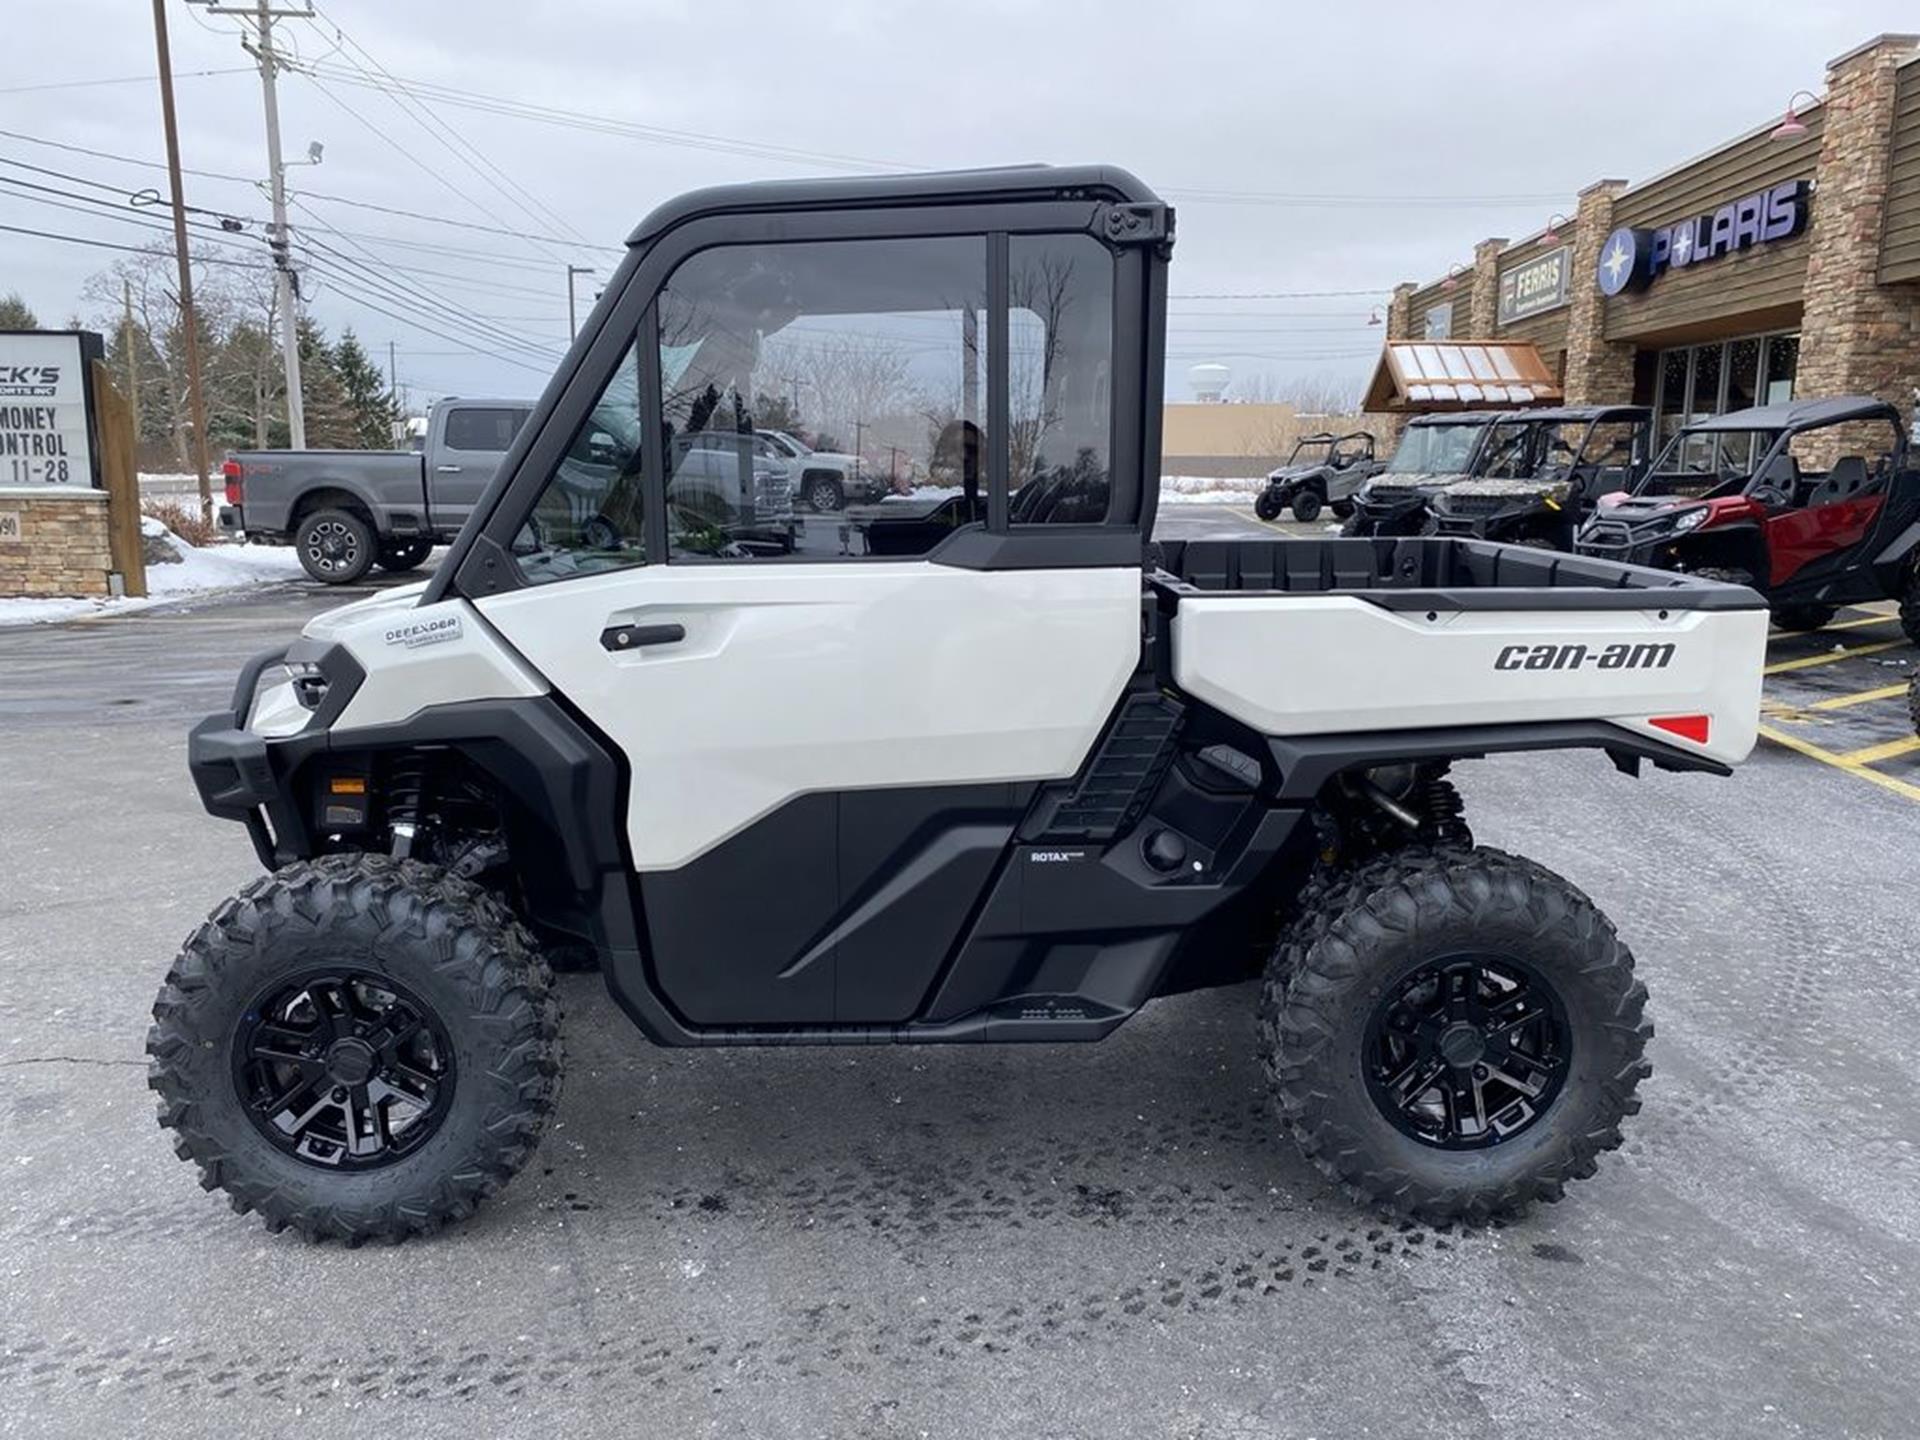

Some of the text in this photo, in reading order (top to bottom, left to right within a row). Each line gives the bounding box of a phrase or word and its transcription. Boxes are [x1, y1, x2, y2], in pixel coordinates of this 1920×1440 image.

[1651, 180, 1798, 275] POLARIS
[1516, 258, 1560, 299] FERRIS
[0, 407, 55, 430] MONEY
[12, 460, 68, 482] 11-28
[0, 518, 16, 535] 90
[386, 618, 456, 640] DEFENDER
[1031, 852, 1069, 862] ROTAX
